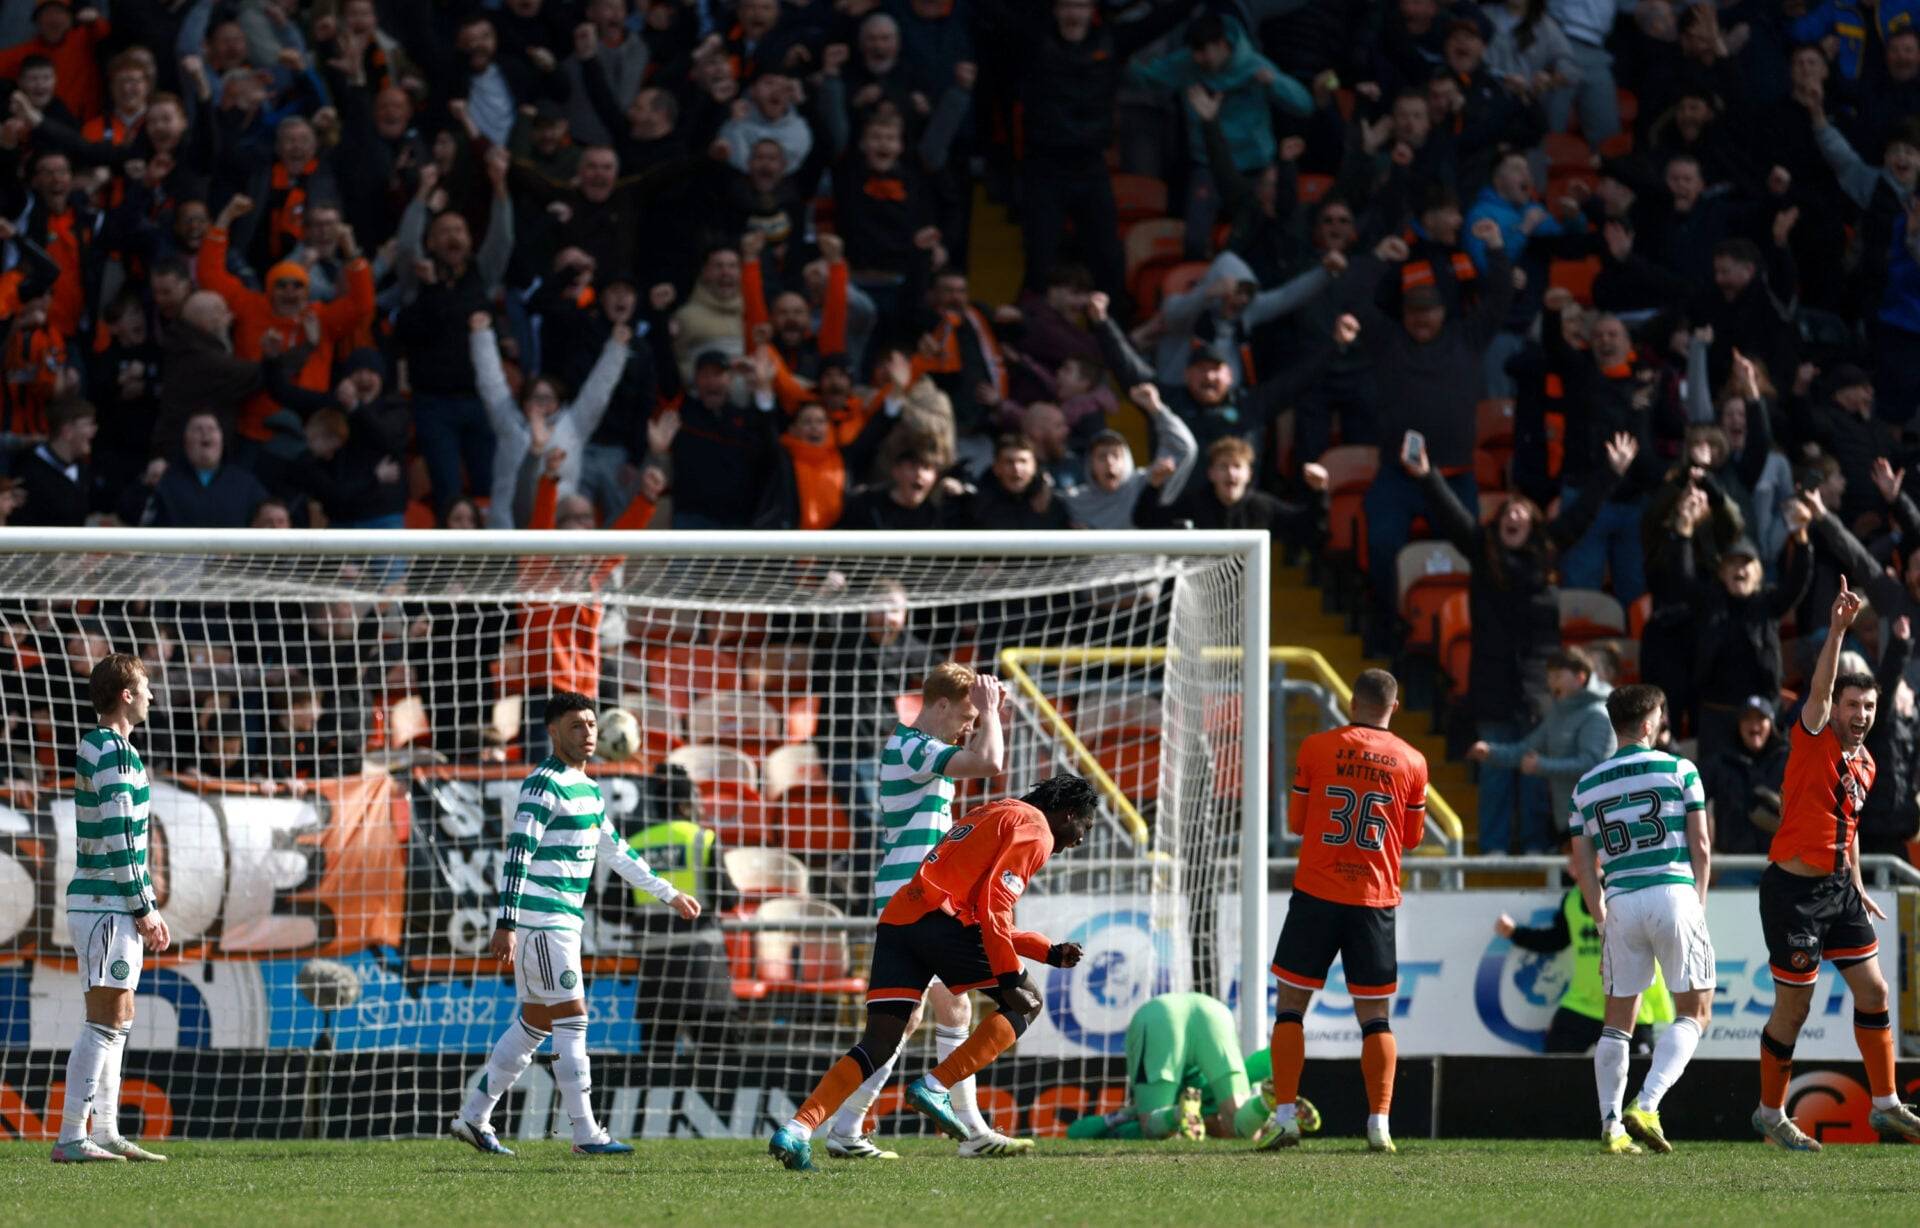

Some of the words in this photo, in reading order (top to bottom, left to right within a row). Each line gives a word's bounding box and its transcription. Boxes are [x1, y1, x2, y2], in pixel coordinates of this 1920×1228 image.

[1362, 751, 1398, 768] KEGS
[1336, 763, 1393, 785] WATTERS
[1322, 785, 1395, 852] 36
[1594, 789, 1667, 857] 63
[399, 997, 496, 1026] 01382
[1711, 1027, 1825, 1040] ENGINNG
